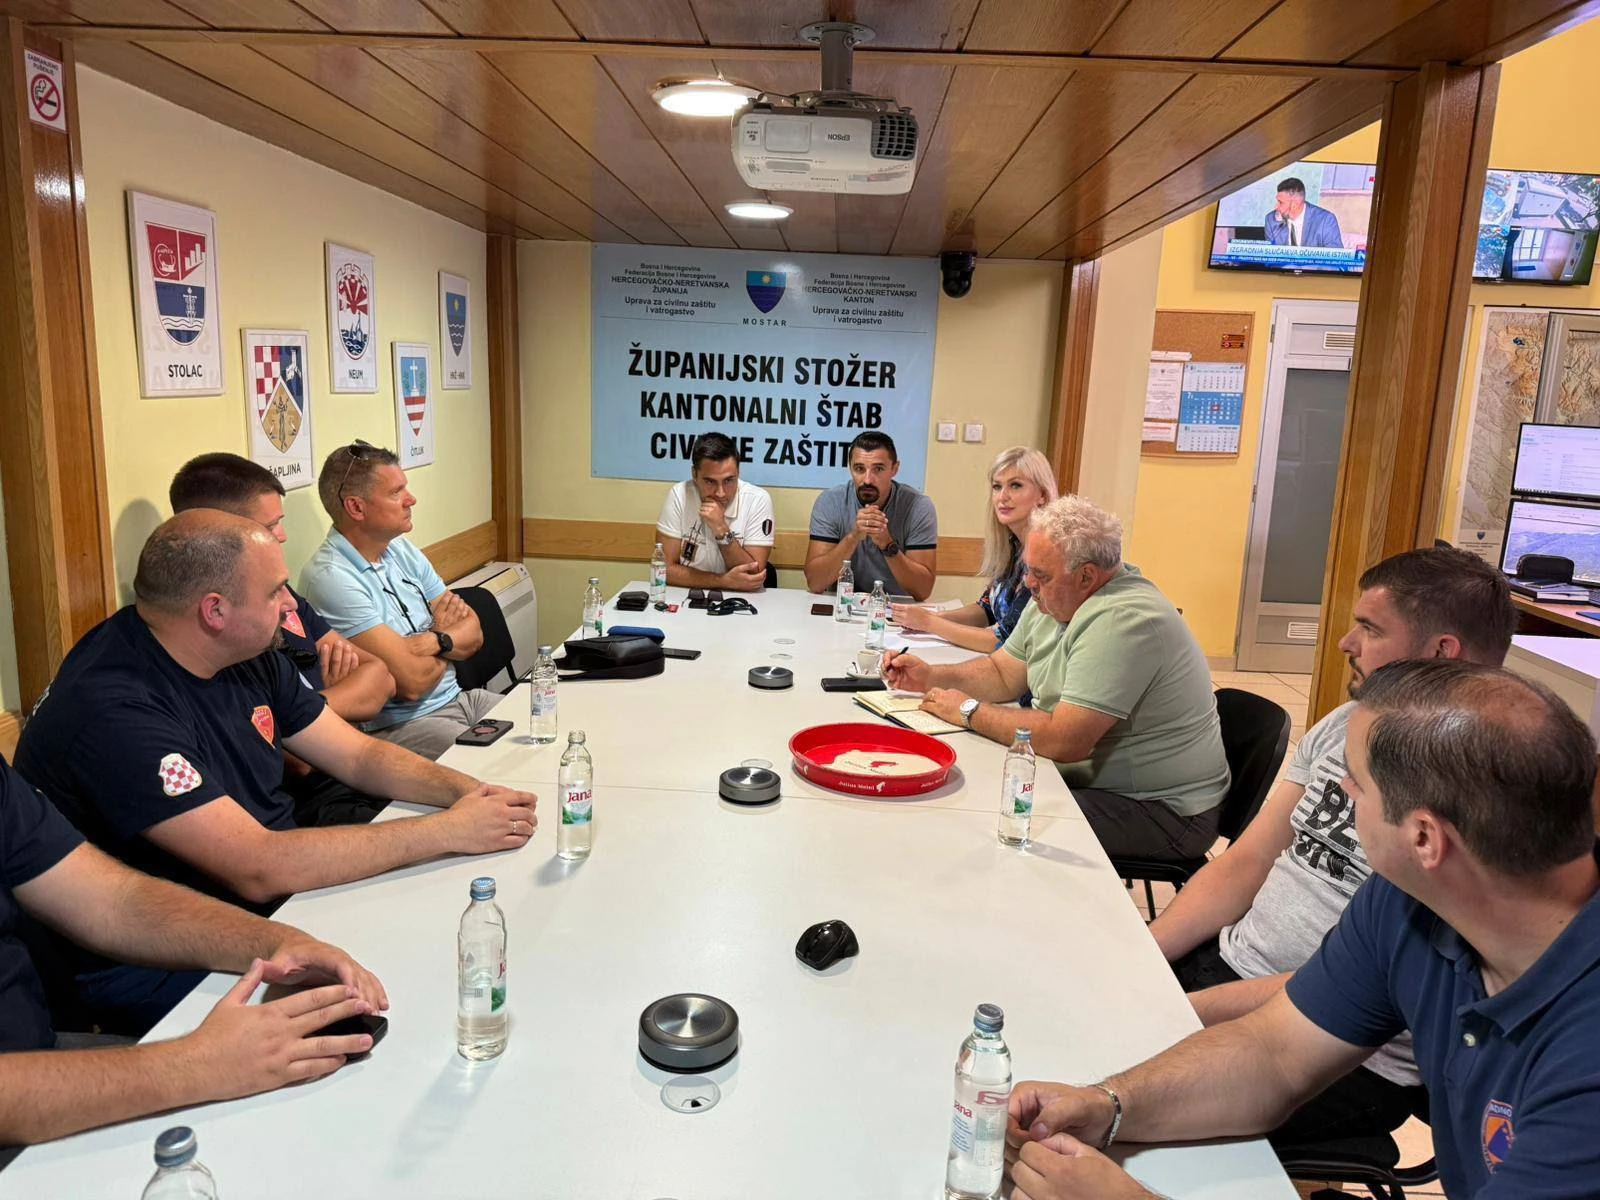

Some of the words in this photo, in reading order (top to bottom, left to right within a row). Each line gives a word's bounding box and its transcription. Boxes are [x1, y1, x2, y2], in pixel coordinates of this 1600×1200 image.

[828, 134, 850, 142] EPSON
[624, 268, 655, 277] Federacija
[664, 264, 701, 272] Hercegovina
[611, 276, 730, 288] HERCEGOVAČKO-NERETVANSKA
[854, 274, 890, 282] Hercegovina
[652, 285, 688, 294] ŽUPANIJA
[802, 286, 917, 297] HERCEGOVAČKO-NERETVANSKI
[624, 296, 652, 306] Uprava
[664, 298, 689, 306] civilnu
[690, 300, 716, 308] zaštitu
[844, 296, 874, 304] KANTON
[650, 308, 695, 316] vatrogastvo
[812, 306, 840, 315] Uprava
[878, 309, 904, 317] zaštitu
[742, 318, 788, 327] MOSTAR
[838, 316, 882, 326] vatrogastvo
[628, 342, 784, 383] ŽUPANIJSKI
[168, 364, 202, 378] STOLAC
[794, 352, 896, 389] STOŽER
[640, 391, 806, 426] KANTONALNI
[816, 393, 882, 429] ŠTAB
[651, 432, 754, 463] CIVE
[764, 433, 850, 468] ZAŠTIT
[567, 788, 592, 803] Jana
[953, 1100, 972, 1118] ana
